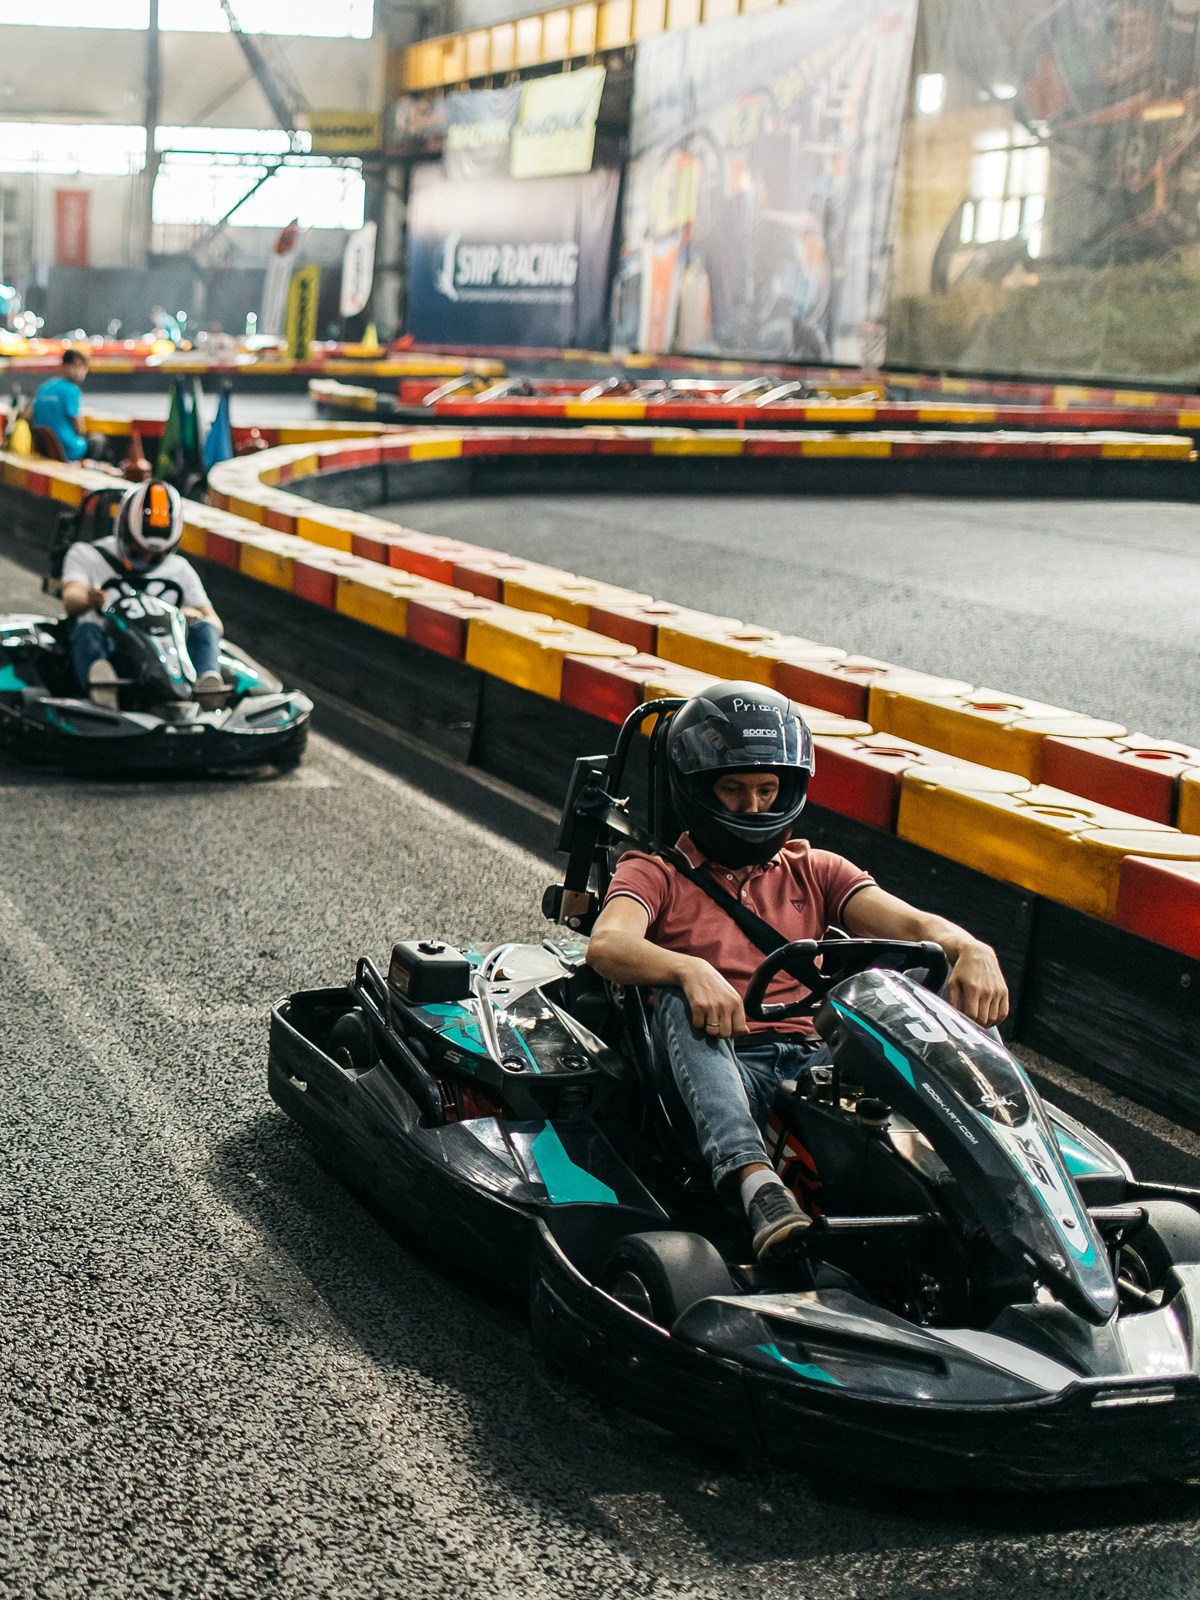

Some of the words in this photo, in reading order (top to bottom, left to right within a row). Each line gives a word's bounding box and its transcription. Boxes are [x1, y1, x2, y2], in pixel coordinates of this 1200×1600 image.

[457, 243, 499, 286] SMP
[500, 241, 579, 287] RACING
[732, 698, 780, 714] Primo
[742, 728, 778, 737] sparco
